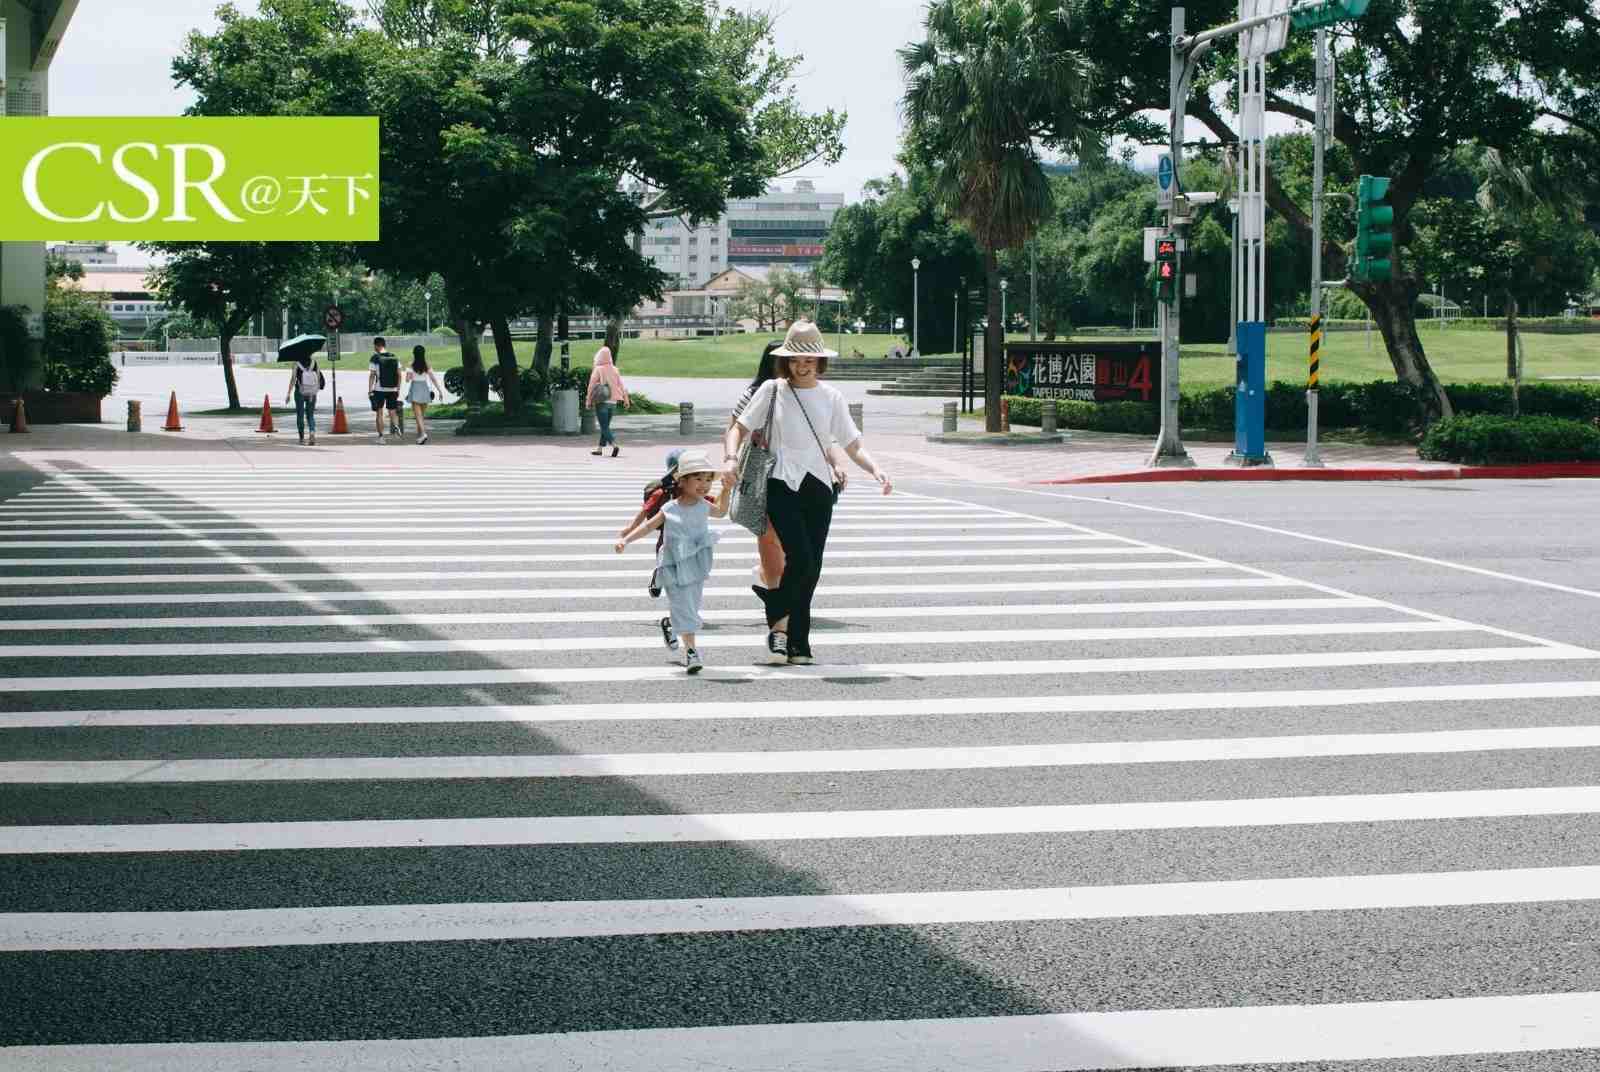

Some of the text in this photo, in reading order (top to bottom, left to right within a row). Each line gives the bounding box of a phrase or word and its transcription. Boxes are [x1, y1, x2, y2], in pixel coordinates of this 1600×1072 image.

[1032, 353, 1096, 385] 花博公園
[1128, 354, 1153, 401] 4
[1032, 387, 1053, 400] TAIPEI
[1054, 387, 1074, 400] EXPO
[1075, 387, 1096, 400] PARK
